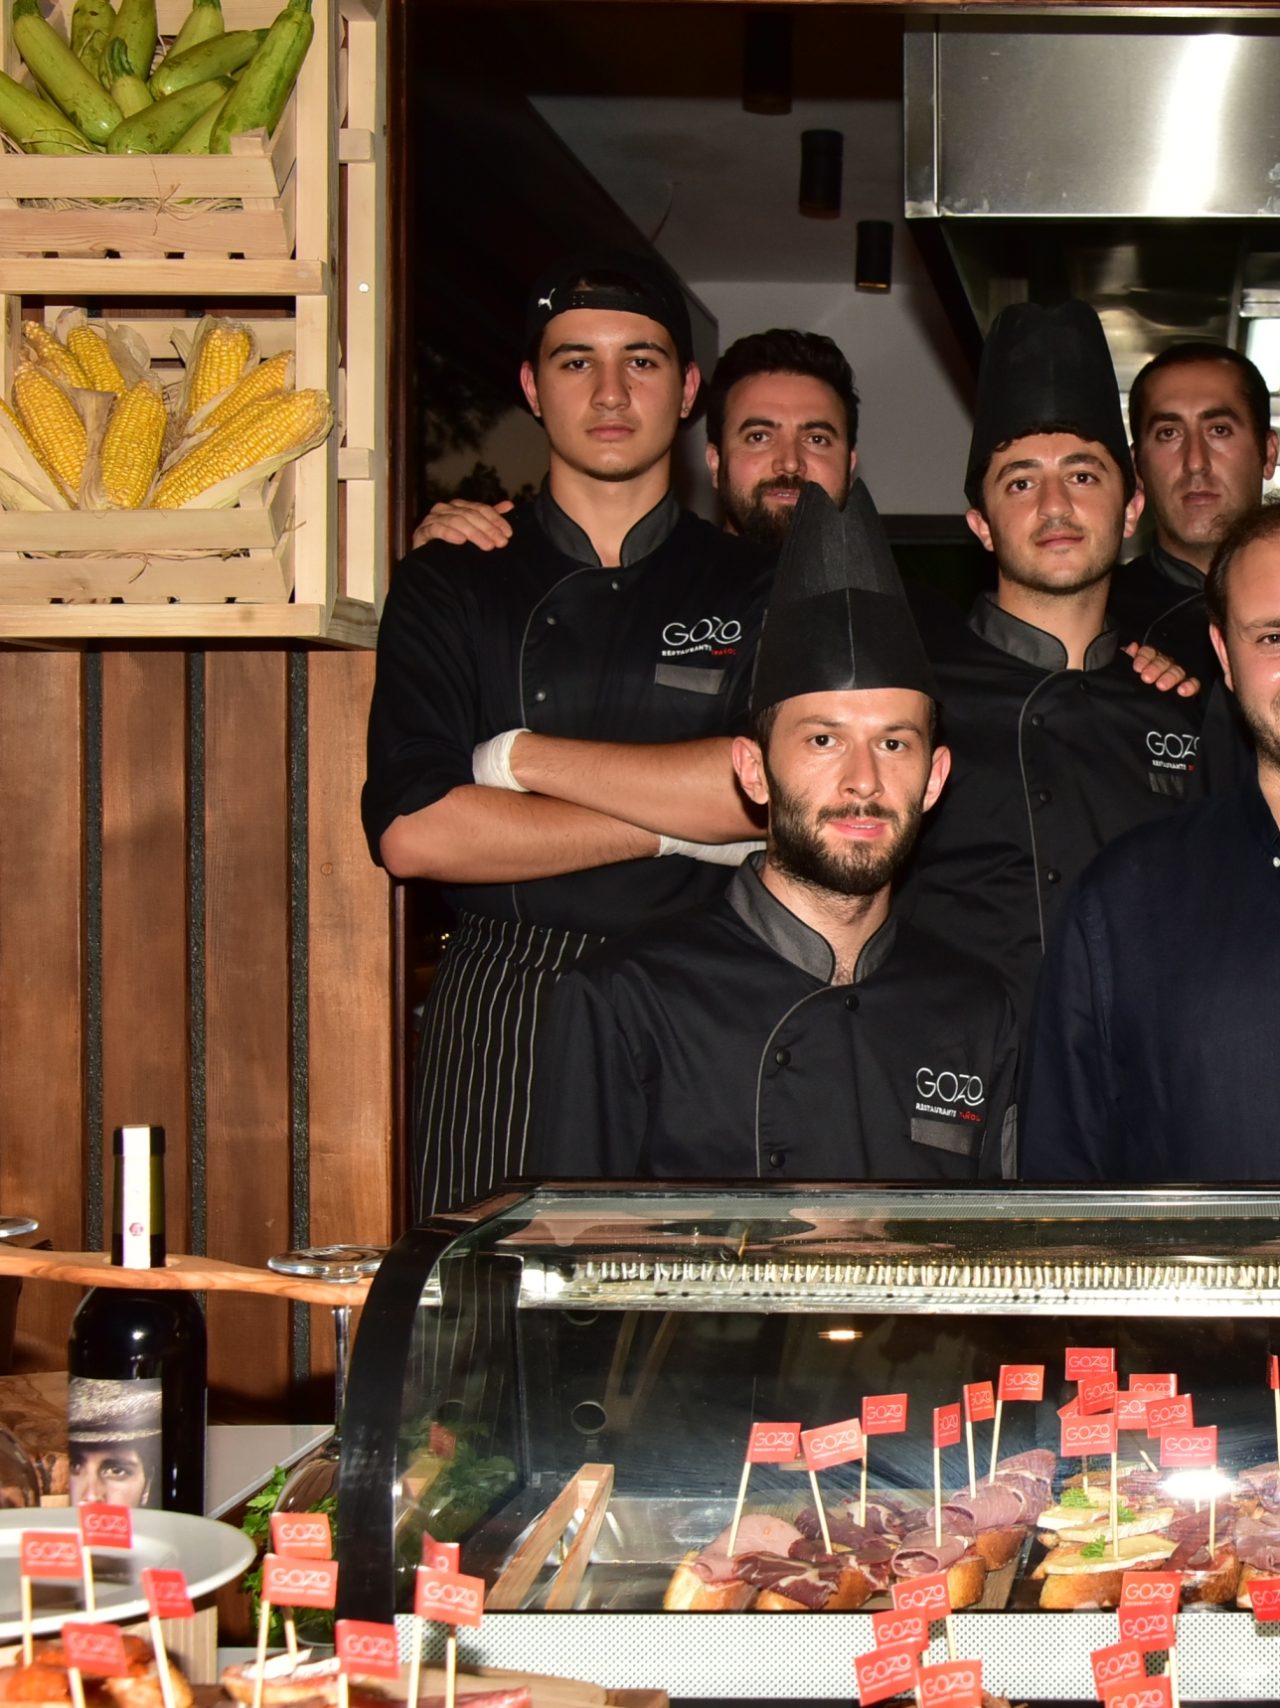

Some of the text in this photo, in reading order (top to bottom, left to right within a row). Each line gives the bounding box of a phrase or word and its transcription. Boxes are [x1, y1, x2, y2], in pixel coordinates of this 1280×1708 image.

[662, 616, 742, 646] GOZO
[915, 1067, 985, 1107] GOZO
[1068, 1356, 1109, 1369] GOZO
[1006, 1373, 1040, 1386] GOZO
[1084, 1381, 1116, 1402] GOZO
[866, 1404, 903, 1420] GOZO
[1150, 1404, 1189, 1423] GOZO
[754, 1432, 796, 1447] GOZO
[809, 1429, 859, 1454] GOZO
[1066, 1423, 1112, 1442] GOZO
[1164, 1437, 1212, 1452] GOZO
[85, 1513, 129, 1534] GOZO
[279, 1522, 327, 1543] GOZO
[27, 1541, 79, 1562] GOZO
[270, 1567, 332, 1588] GOZO
[423, 1580, 480, 1609] GOZO
[898, 1584, 946, 1610] GOZO
[1125, 1583, 1175, 1600] GOZO
[877, 1617, 923, 1642] GOZO
[1122, 1614, 1169, 1637] GOZO
[68, 1632, 118, 1652] GOZO
[344, 1634, 394, 1659] GOZO
[860, 1653, 912, 1684] GOZO
[1096, 1651, 1140, 1680] GOZO
[922, 1670, 976, 1697] GOZO
